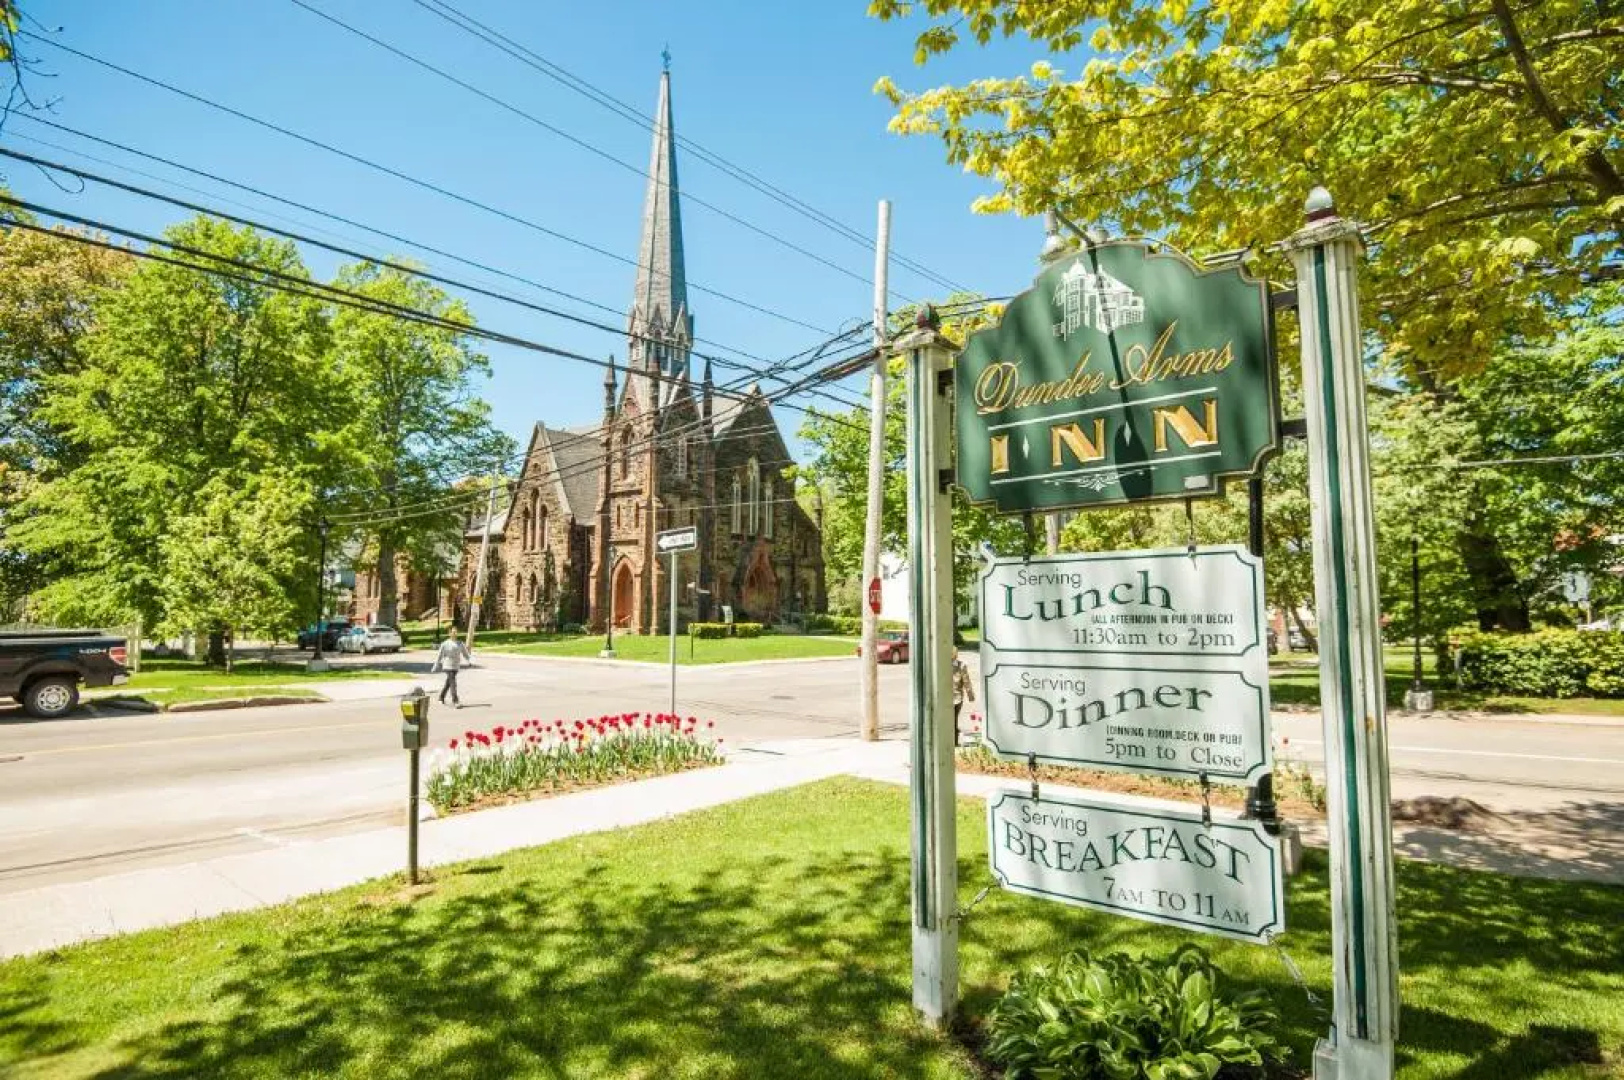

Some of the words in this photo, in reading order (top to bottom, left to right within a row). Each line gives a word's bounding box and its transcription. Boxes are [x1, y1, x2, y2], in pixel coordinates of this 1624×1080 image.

[973, 351, 1104, 415] Dundee
[1109, 318, 1235, 391] Arms
[1017, 570, 1081, 588] Serving
[999, 570, 1176, 622] Lunch
[1072, 627, 1147, 647] 11:30am
[1158, 631, 1178, 646] to
[1187, 627, 1235, 650] 2pm
[1020, 672, 1086, 696] Serving
[1008, 683, 1214, 730] Dinner
[1105, 736, 1146, 759] 5pm
[1156, 744, 1176, 760] to
[1190, 746, 1243, 767] Close
[1022, 805, 1088, 837] Serving
[1003, 818, 1251, 885] BREAKFAST
[1155, 889, 1186, 911] TO
